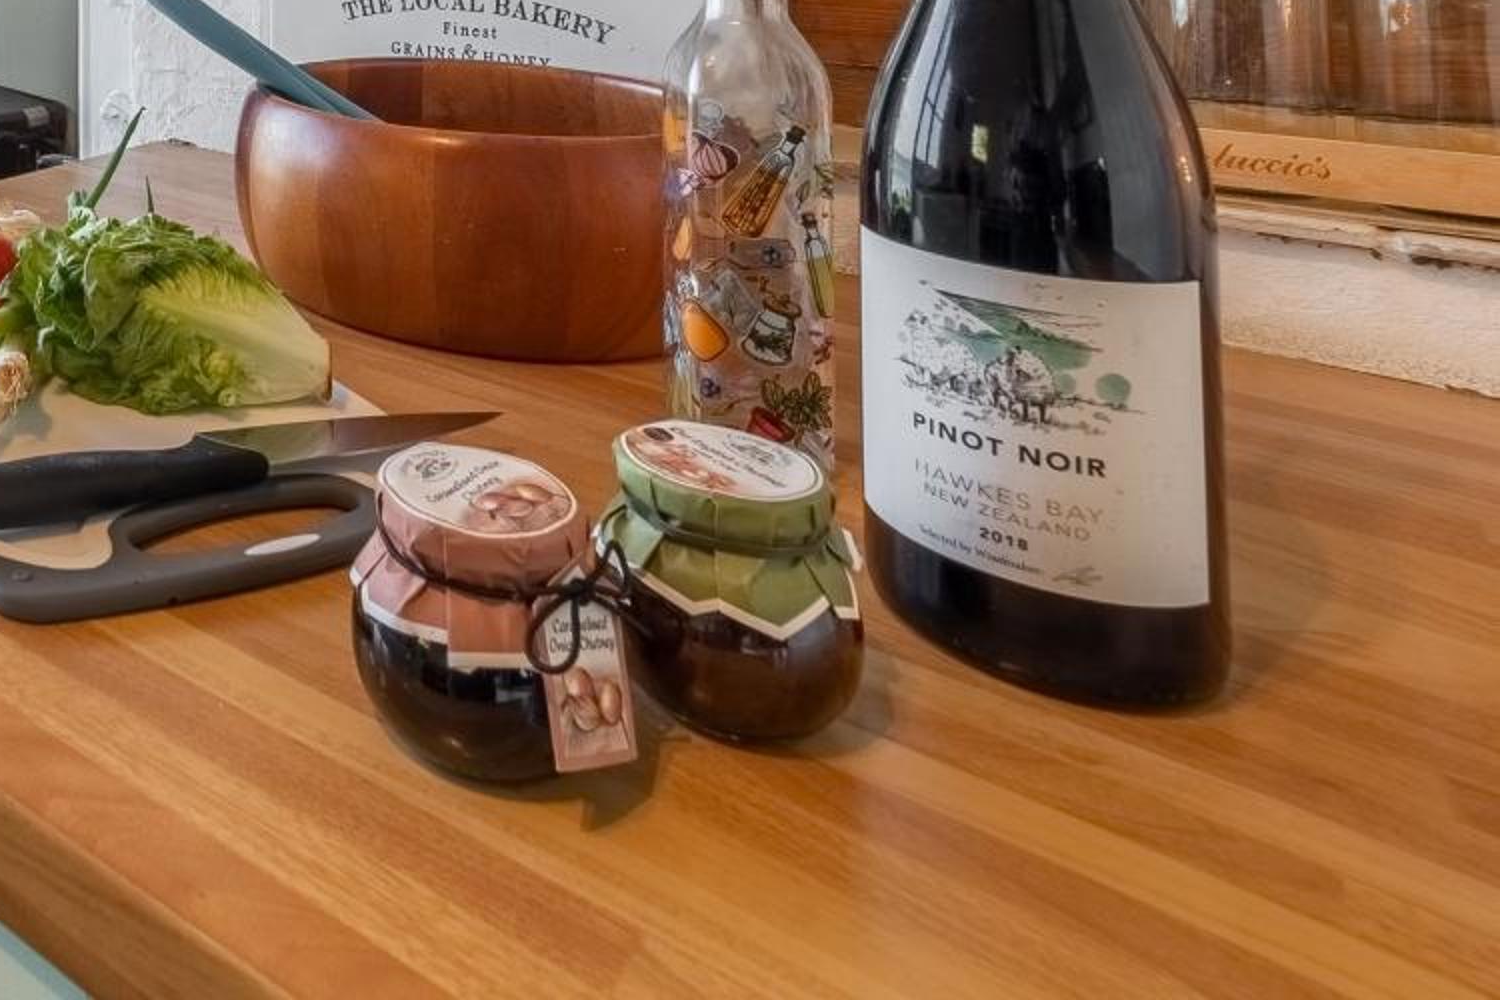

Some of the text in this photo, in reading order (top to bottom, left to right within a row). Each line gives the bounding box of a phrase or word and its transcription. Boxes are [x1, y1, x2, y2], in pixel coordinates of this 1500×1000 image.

[442, 21, 498, 40] Finest
[390, 41, 456, 61] GRAINS
[462, 43, 477, 60] &
[1213, 142, 1332, 180] luccio's
[912, 411, 1107, 479] PINOT NOIR
[915, 458, 1104, 525] HAWKES BAY
[924, 482, 1092, 542] NEW ZEALAND
[979, 526, 1030, 552] 2018
